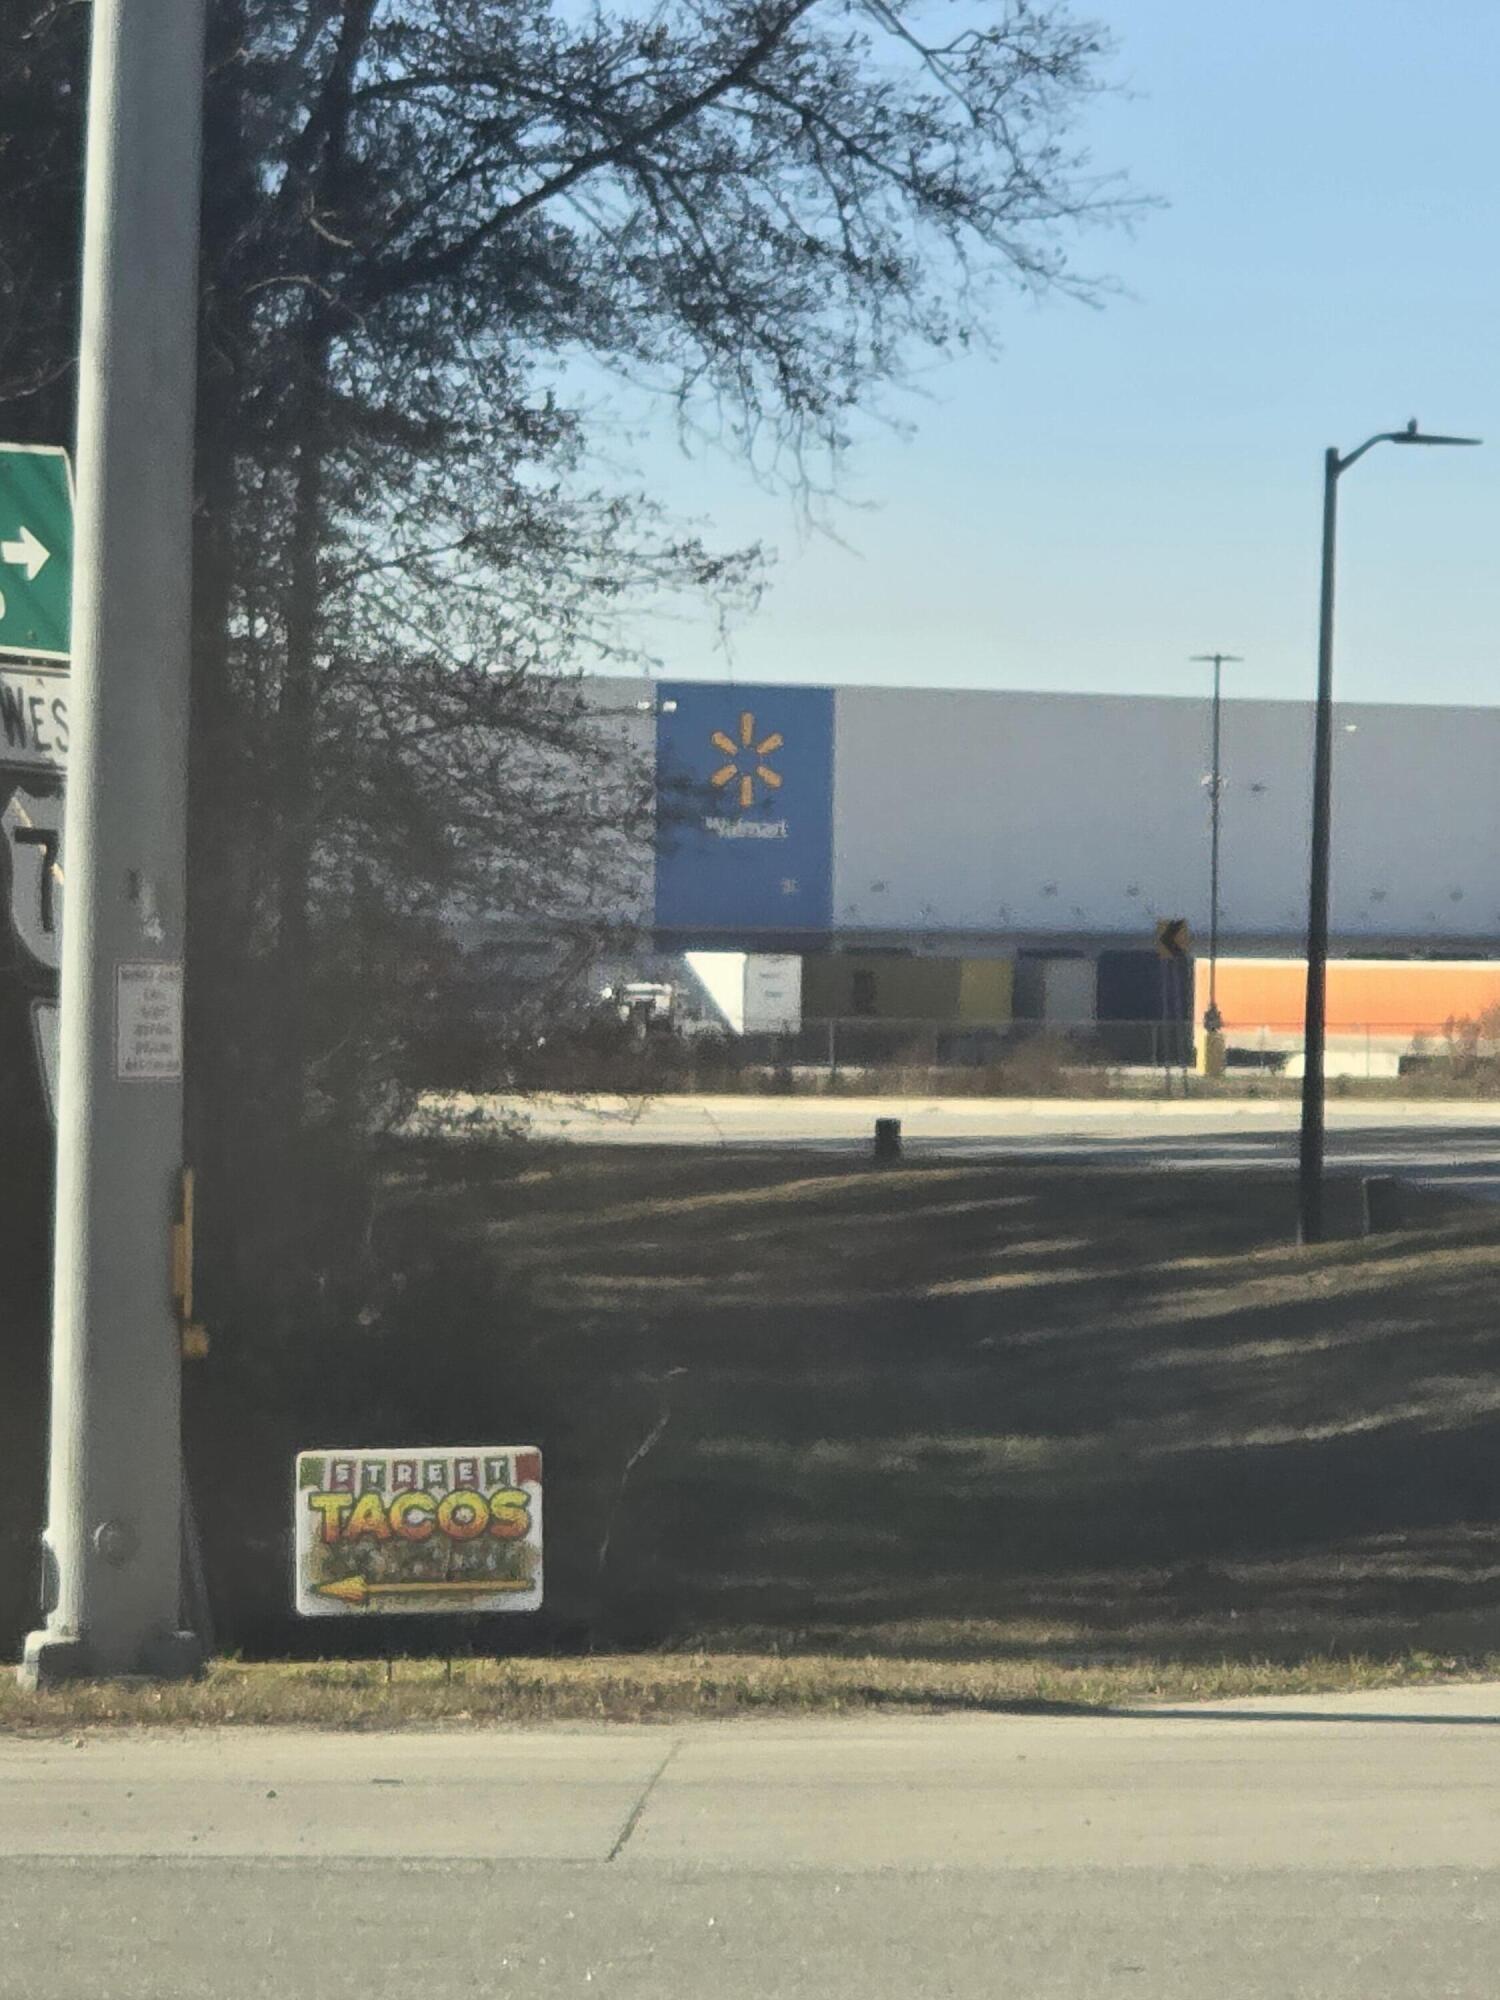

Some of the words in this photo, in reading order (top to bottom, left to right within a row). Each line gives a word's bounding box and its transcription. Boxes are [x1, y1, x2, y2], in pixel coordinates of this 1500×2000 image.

[0, 687, 69, 752] WES
[14, 826, 58, 932] 7
[335, 1460, 505, 1483] STREET
[309, 1488, 531, 1542] TACOS
